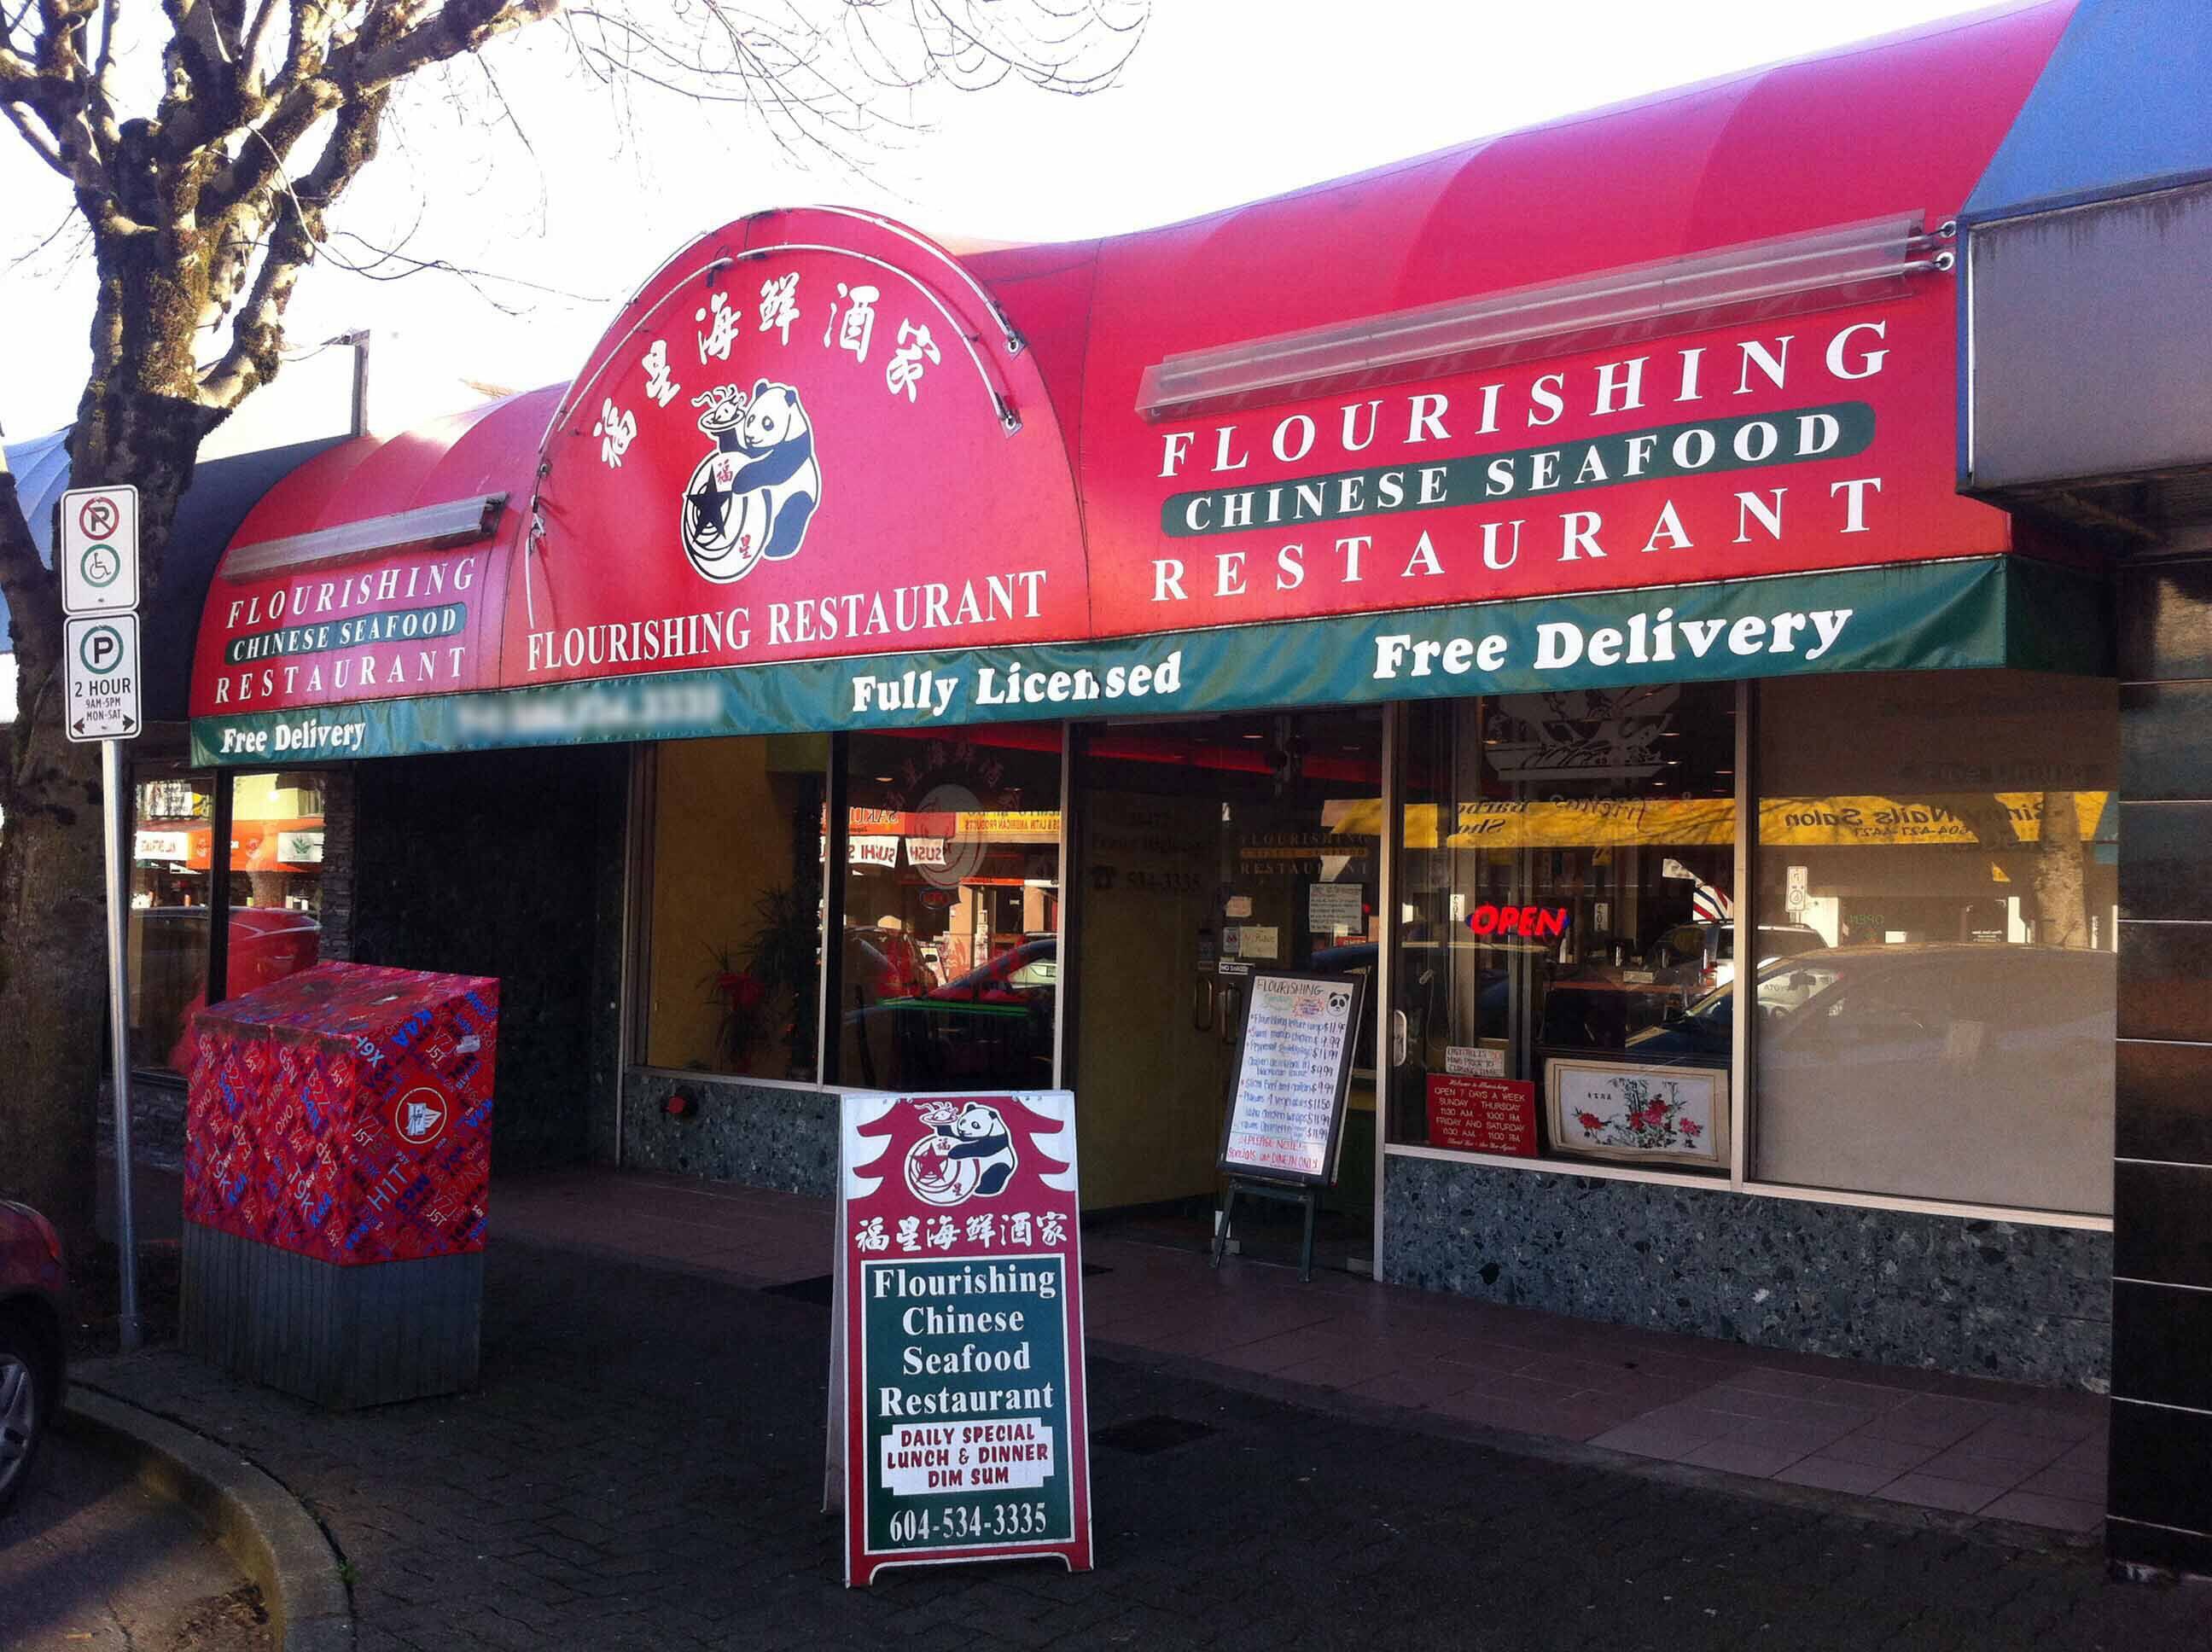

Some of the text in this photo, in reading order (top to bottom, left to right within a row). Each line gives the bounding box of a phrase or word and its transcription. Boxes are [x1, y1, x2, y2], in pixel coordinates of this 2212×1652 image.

[1157, 320, 1890, 478] FLOURISHING
[1185, 413, 1842, 532] CHINESE SEAFOOD
[1151, 477, 1883, 602] RESTAURANT
[225, 556, 475, 629] FLOURISHING
[233, 608, 457, 662] CHINESE SEAFOOD
[527, 570, 1048, 672] FLOURISHING RESTAURANT
[1373, 607, 1854, 680] Free Delivery
[74, 678, 131, 698] 2 HOUR
[214, 647, 467, 705] RESTAURANT
[852, 651, 1183, 718] Fully Licensed
[85, 697, 121, 708] 9AM-5PM
[86, 709, 121, 721] MON-SAT
[219, 718, 366, 754] Free Delivery
[1471, 905, 1568, 936] OPEN
[1257, 979, 1324, 996] FLOURISHING
[1434, 1087, 1456, 1096] OPEN
[1469, 1090, 1488, 1099] DAYS
[1492, 1091, 1499, 1100] A
[1502, 1092, 1525, 1102] WEEK
[1439, 1098, 1521, 1112] SUNDAY THURSDAY
[1435, 1117, 1525, 1131] FRIDAY AND SATURDAY
[855, 1211, 1068, 1253] 福星海鮮酒家
[873, 1265, 1057, 1299] Flourishing
[902, 1304, 1025, 1335] Chinese
[903, 1341, 1031, 1376] Seafood
[878, 1382, 1054, 1416] Restaurant
[900, 1423, 1035, 1447] DAILY SPECIAL
[888, 1443, 1049, 1469] LUNCH & DINNER
[928, 1466, 1010, 1488] DIM SUM
[889, 1502, 1047, 1541] 604-534-3335
